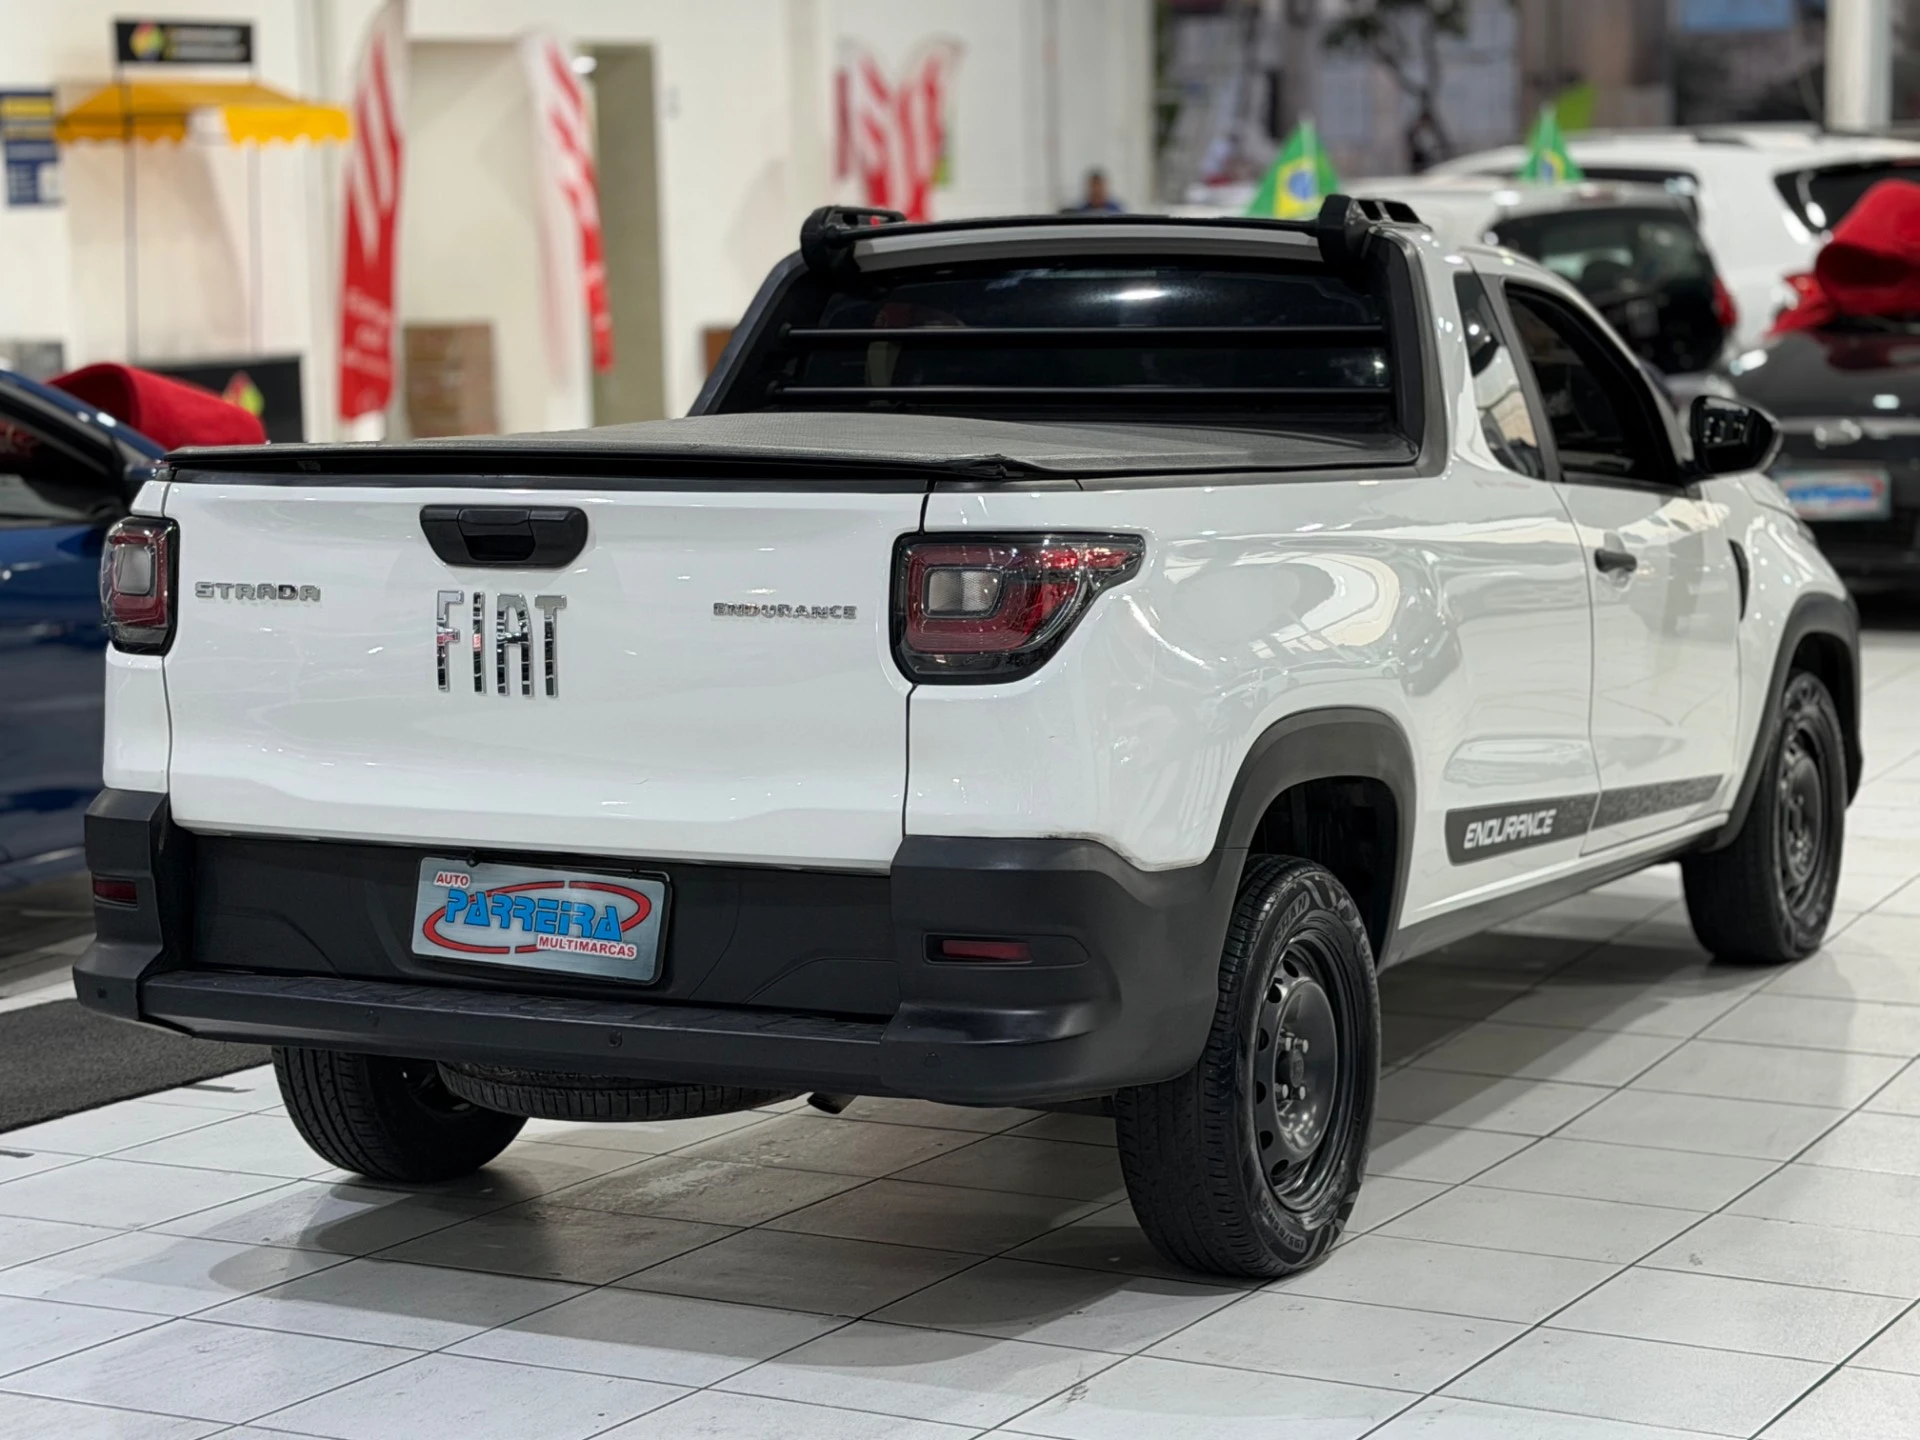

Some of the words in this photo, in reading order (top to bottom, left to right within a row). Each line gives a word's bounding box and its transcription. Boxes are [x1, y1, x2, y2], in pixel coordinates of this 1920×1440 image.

[195, 581, 321, 602] STRADA
[713, 602, 858, 620] ENDURANCE
[437, 589, 567, 698] FIAT
[1463, 808, 1558, 850] ENDURANCE
[435, 871, 470, 887] AUTO
[444, 888, 623, 943] PARREIRA
[538, 936, 637, 958] MULTIMARCAS
